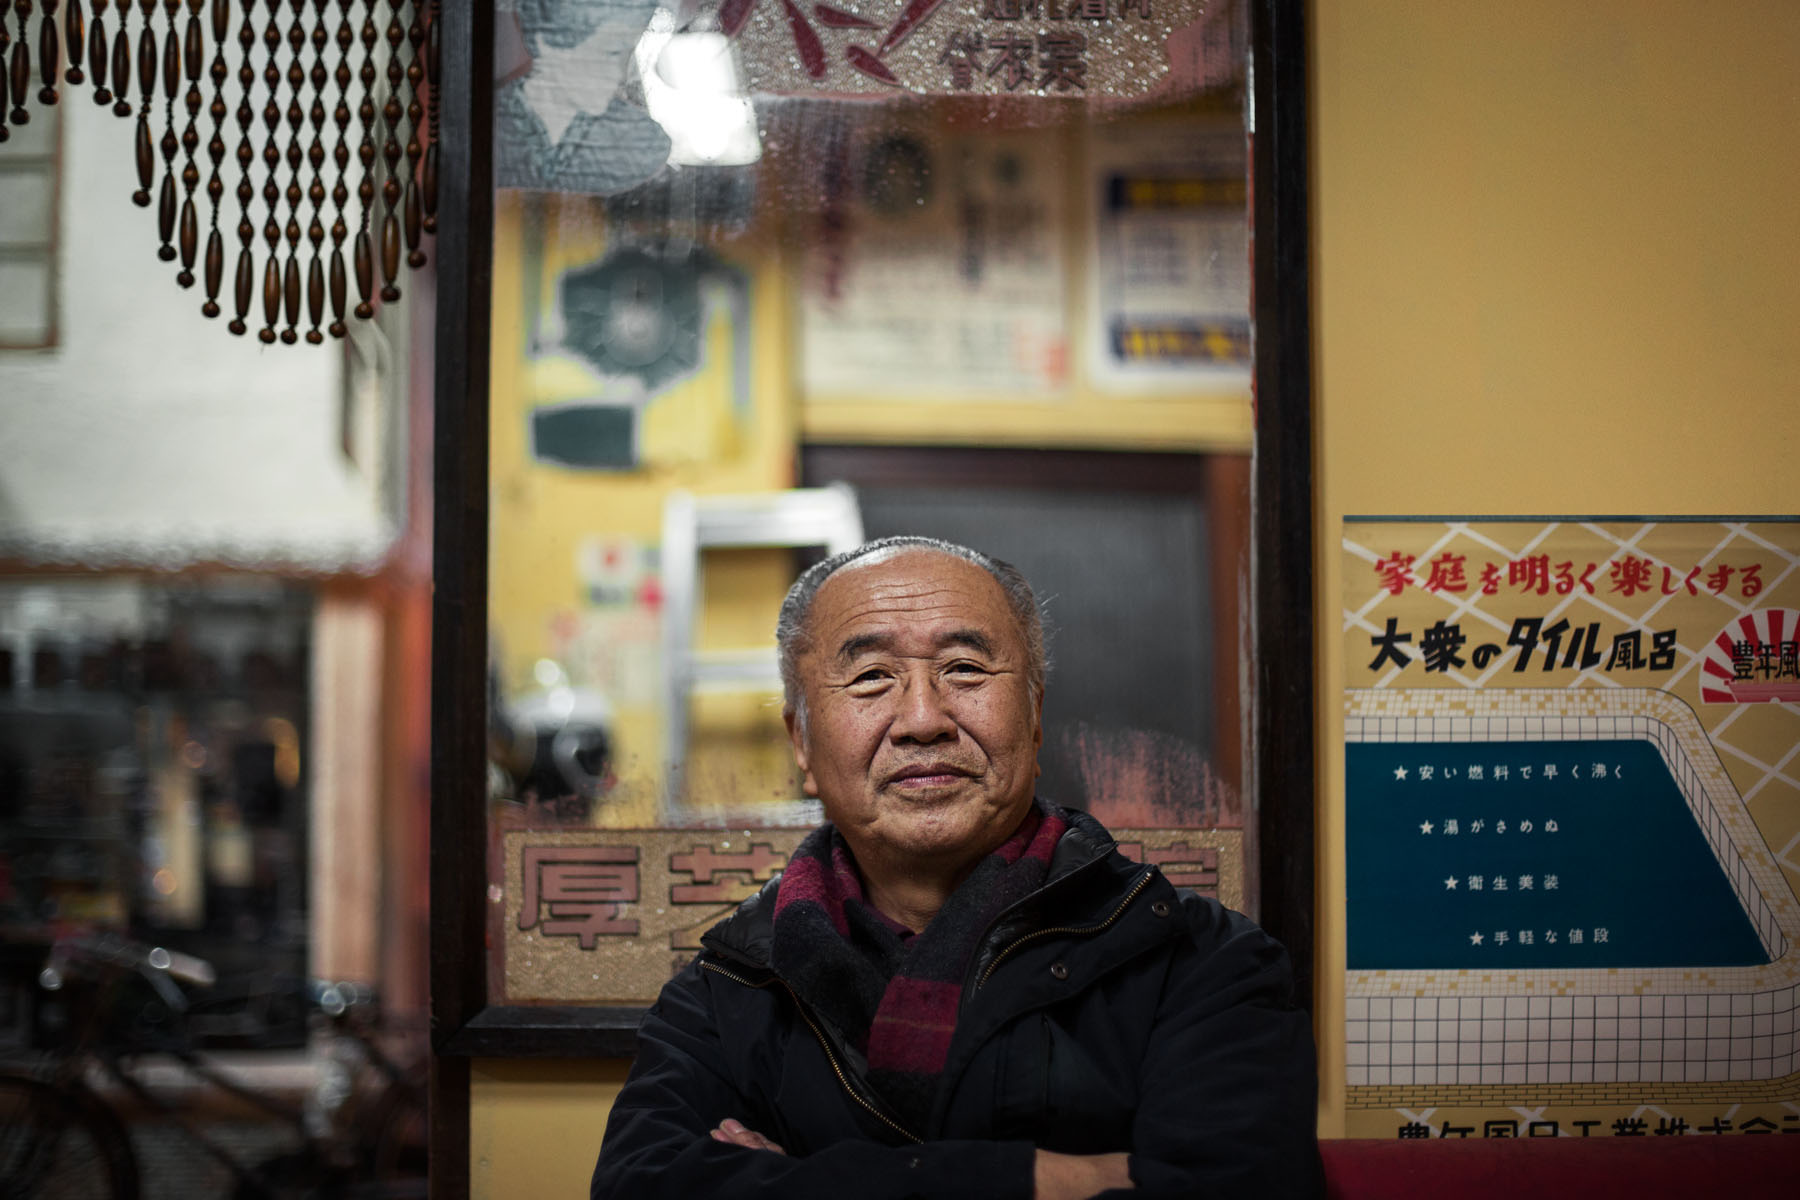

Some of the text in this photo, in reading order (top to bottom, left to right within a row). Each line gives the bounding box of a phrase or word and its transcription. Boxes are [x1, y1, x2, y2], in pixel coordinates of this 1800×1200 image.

[1374, 551, 1763, 597] 家庭を明るく楽しくする
[1368, 617, 1677, 672] 大衆のタイル風呂
[1418, 762, 1625, 782] 安い燃料で早く沸く
[1443, 818, 1559, 835] 湯がさめぬ
[1494, 927, 1610, 946] 手軽な値段
